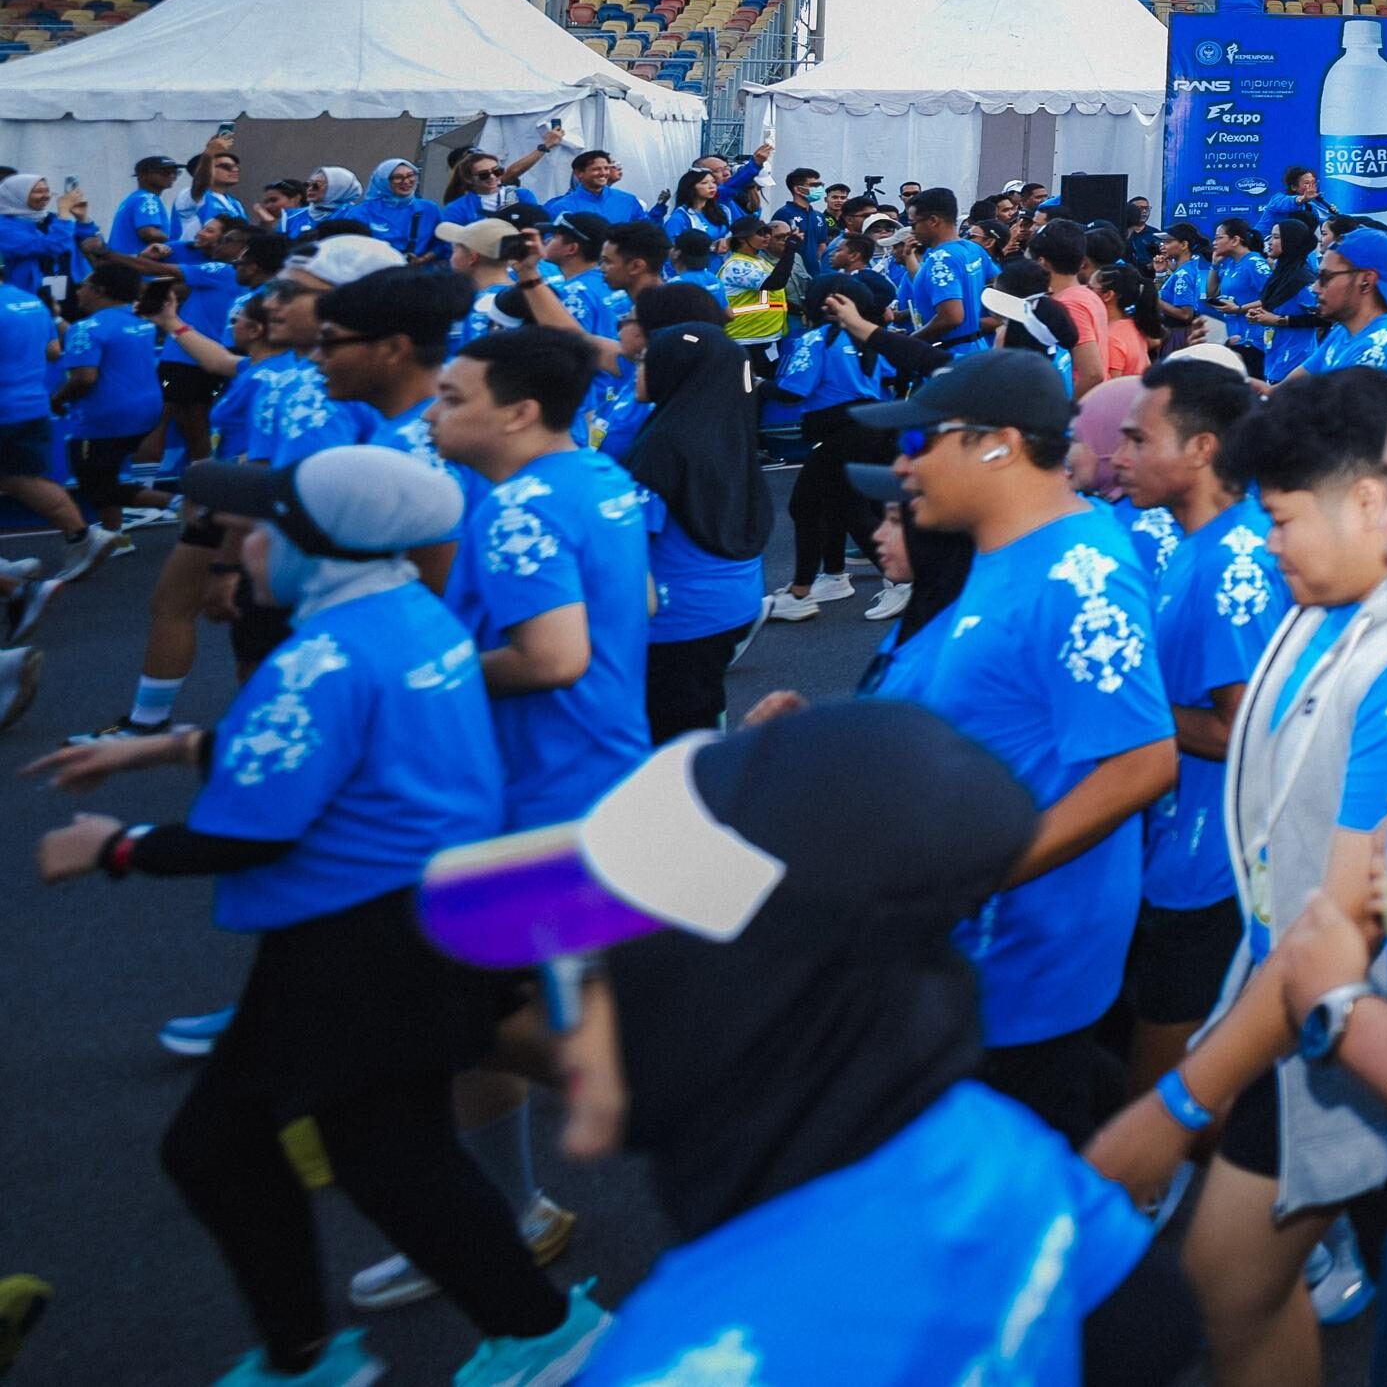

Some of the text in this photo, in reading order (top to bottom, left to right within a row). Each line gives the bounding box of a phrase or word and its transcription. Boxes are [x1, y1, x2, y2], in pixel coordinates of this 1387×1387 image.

[1173, 80, 1231, 92] RANS
[1222, 113, 1261, 125] erspo
[1219, 133, 1259, 142] Rexona
[1325, 161, 1387, 173] SWEAT
